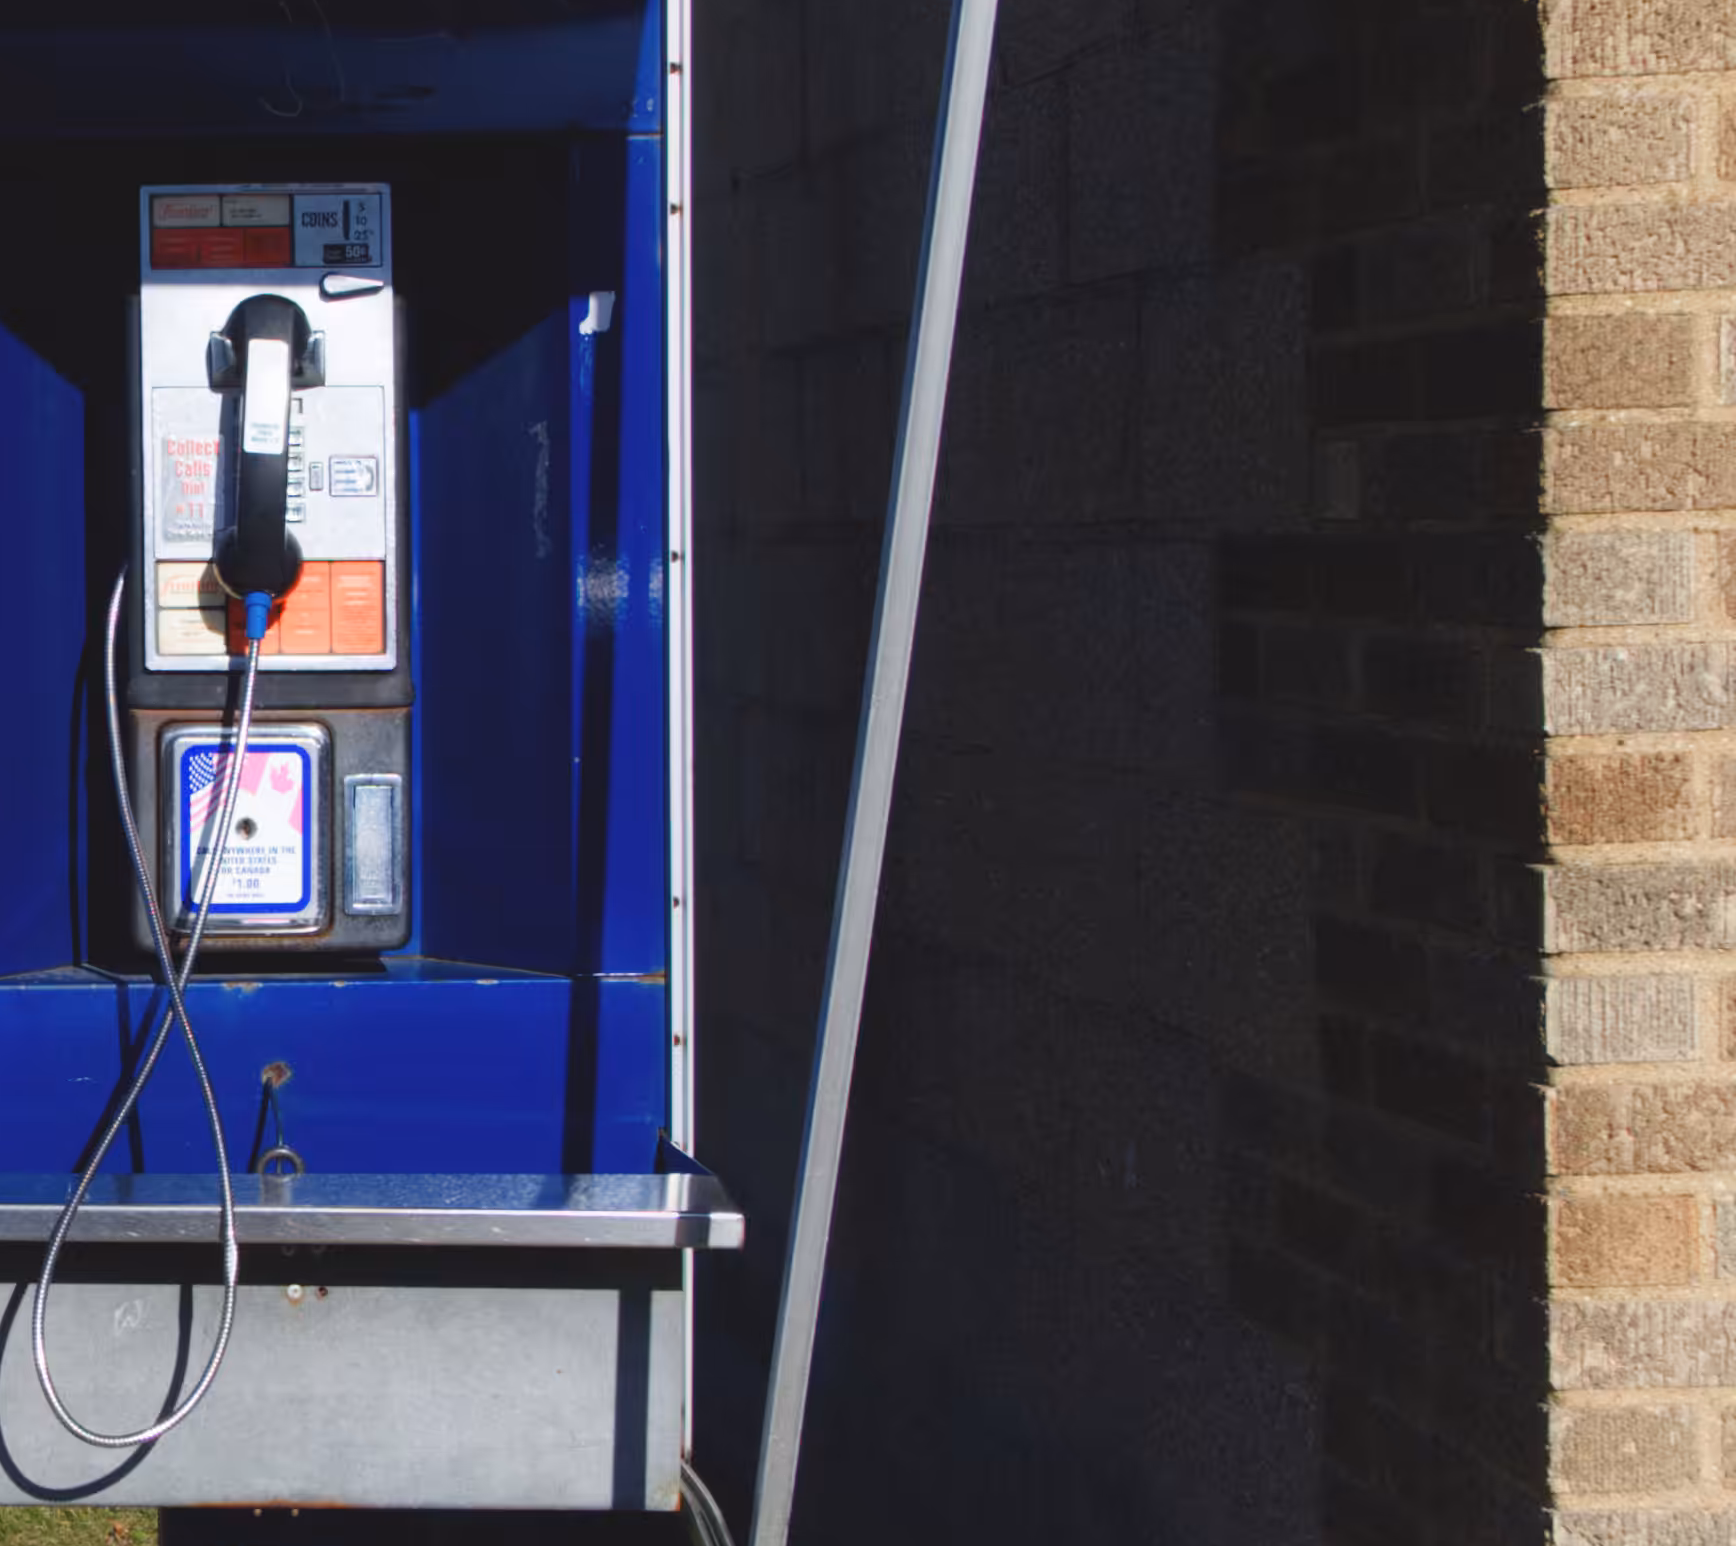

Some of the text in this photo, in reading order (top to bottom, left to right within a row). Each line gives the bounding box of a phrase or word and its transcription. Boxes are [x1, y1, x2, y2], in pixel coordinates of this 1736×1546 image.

[301, 211, 339, 228] COINS
[167, 439, 221, 456] Collect
[175, 460, 212, 477] Calls
[220, 846, 265, 854] NYWHERE
